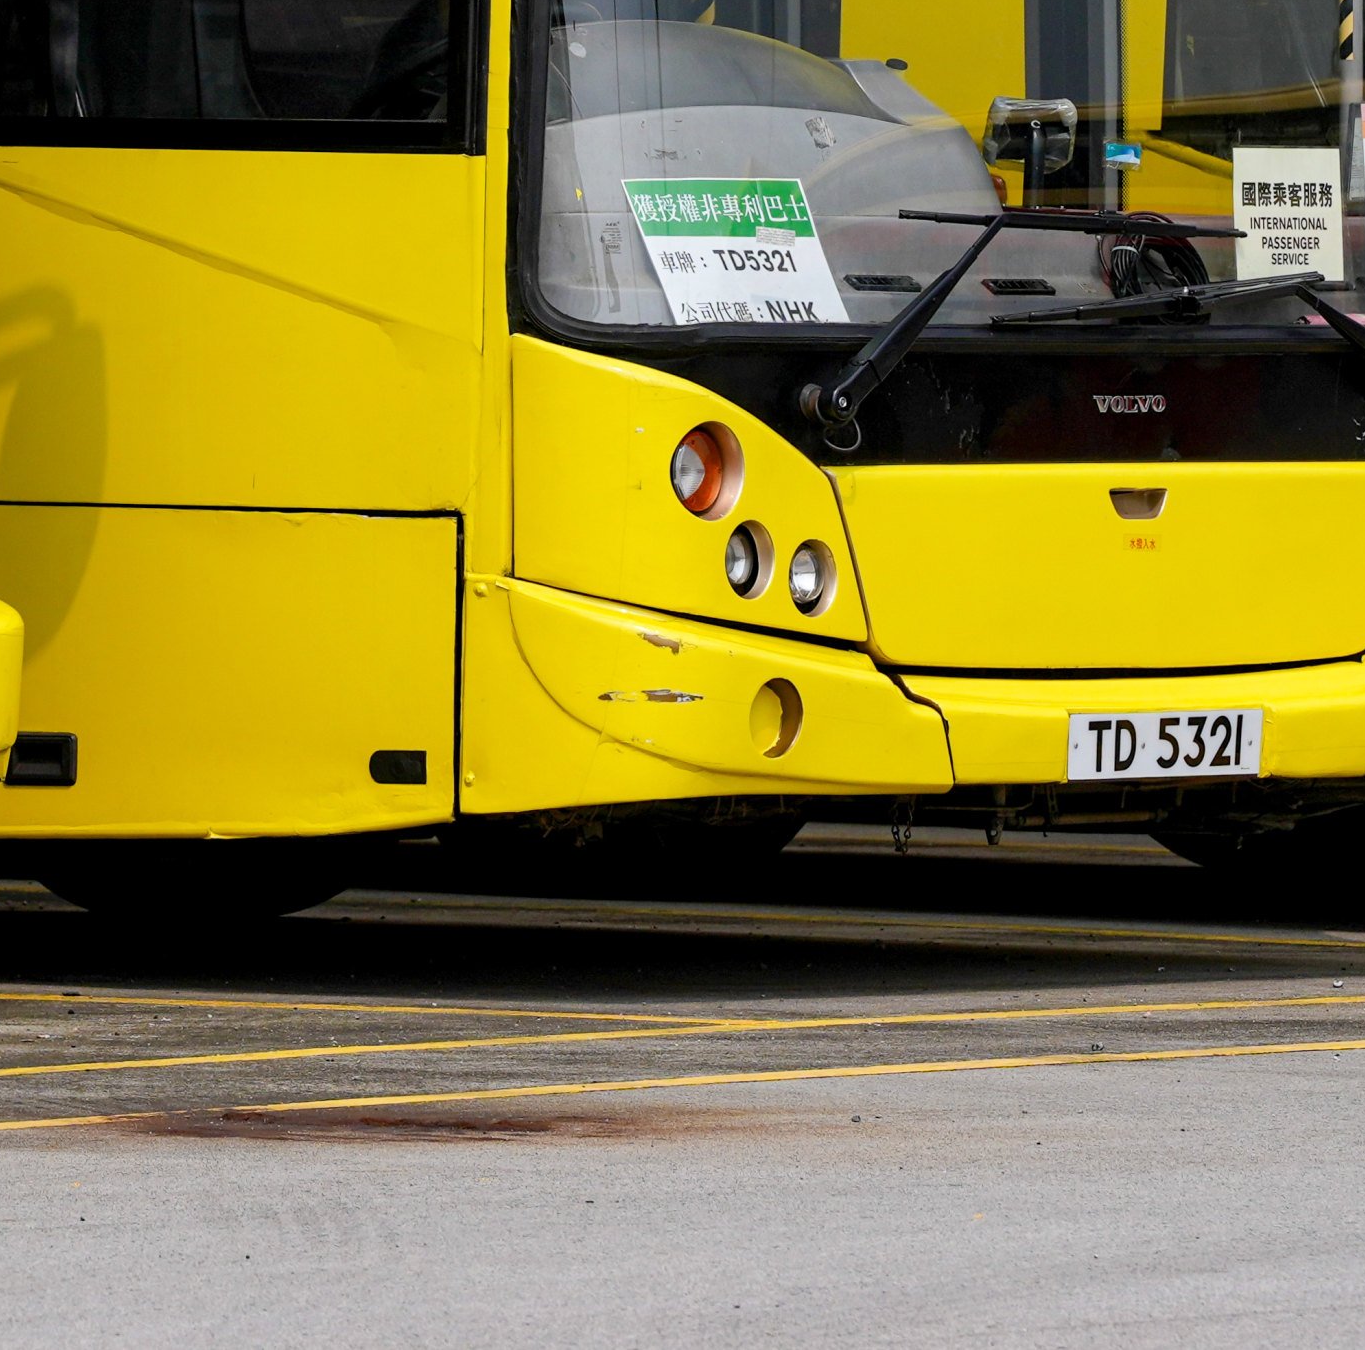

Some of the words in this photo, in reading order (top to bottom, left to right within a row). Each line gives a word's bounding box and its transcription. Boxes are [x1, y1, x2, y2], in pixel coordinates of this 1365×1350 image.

[1241, 181, 1333, 208] 國際乘客服務
[633, 193, 809, 223] 獲授權非專利巴士
[1249, 217, 1328, 231] INTERNATIONAL
[1261, 236, 1320, 250] PASSENGER
[712, 249, 798, 273] TD5321
[1271, 253, 1310, 266] SERVICE
[1093, 394, 1167, 414] VOLVO
[1088, 718, 1137, 773] TD
[1156, 713, 1244, 770] 5321
